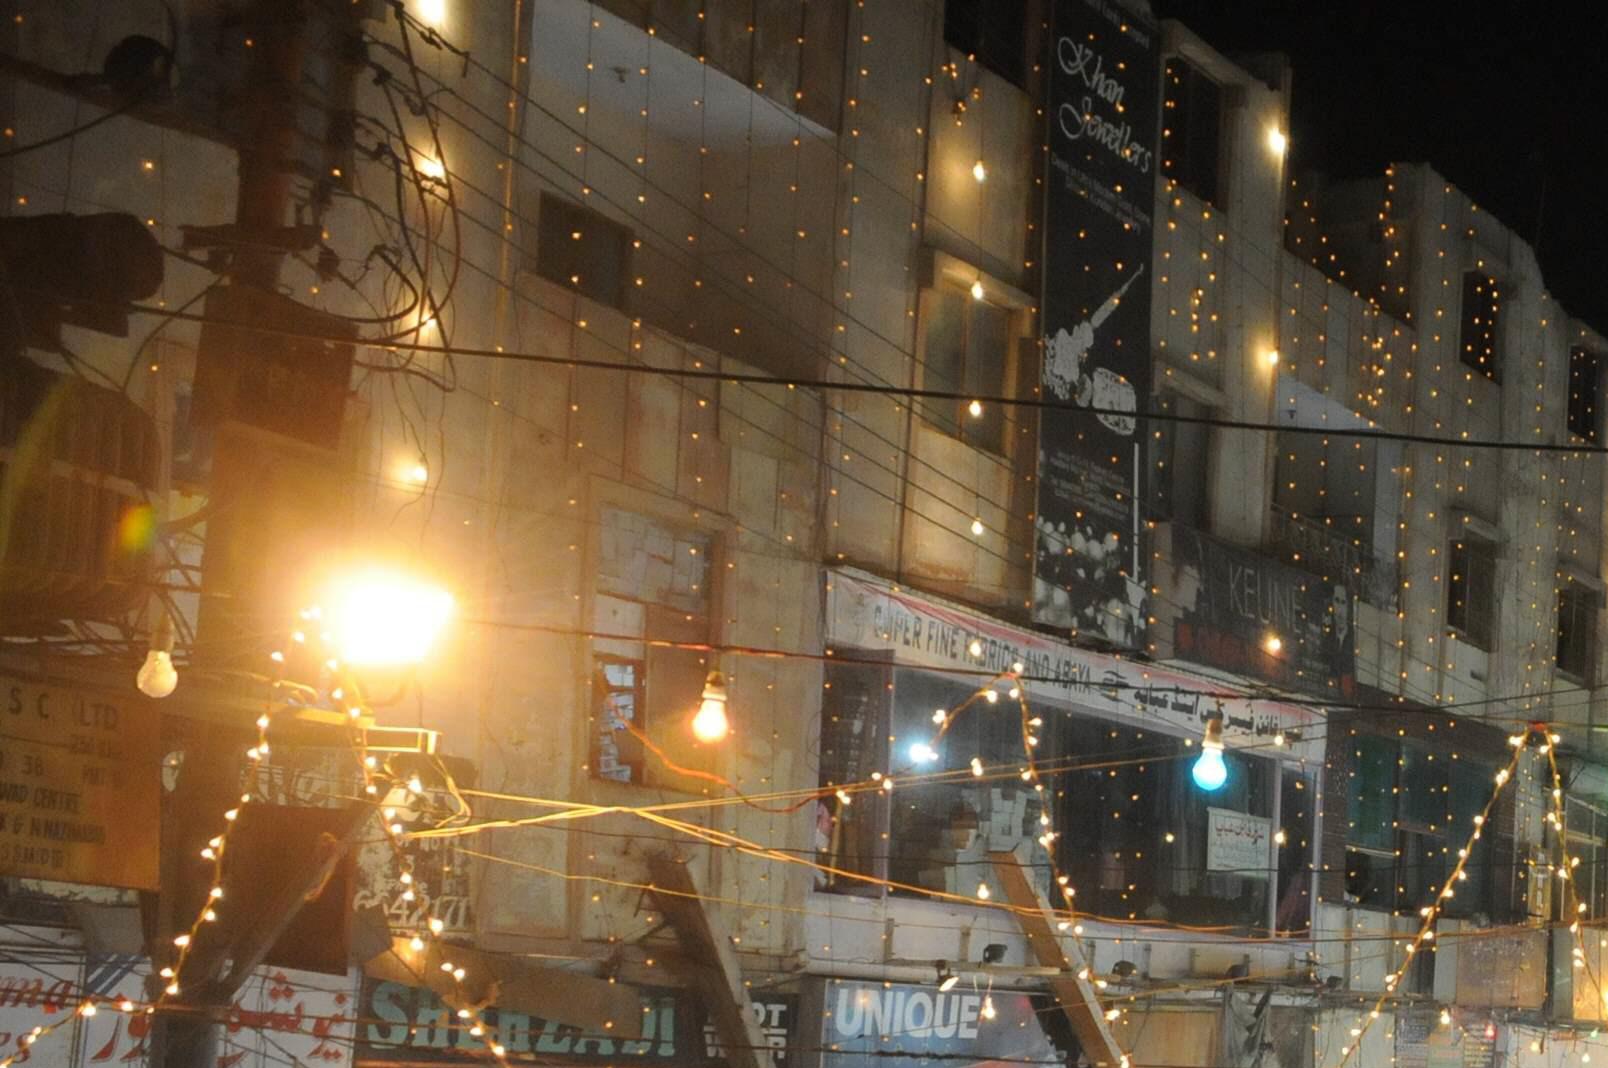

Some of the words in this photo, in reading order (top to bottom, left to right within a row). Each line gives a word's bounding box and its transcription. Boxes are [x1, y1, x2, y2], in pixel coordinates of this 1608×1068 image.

[1058, 37, 1125, 103] Khan
[1229, 563, 1302, 634] KEUNE
[927, 620, 959, 656] FINE
[1024, 650, 1051, 682] AND
[1055, 659, 1092, 694] ABAYA
[835, 986, 982, 1039] UNIQUE
